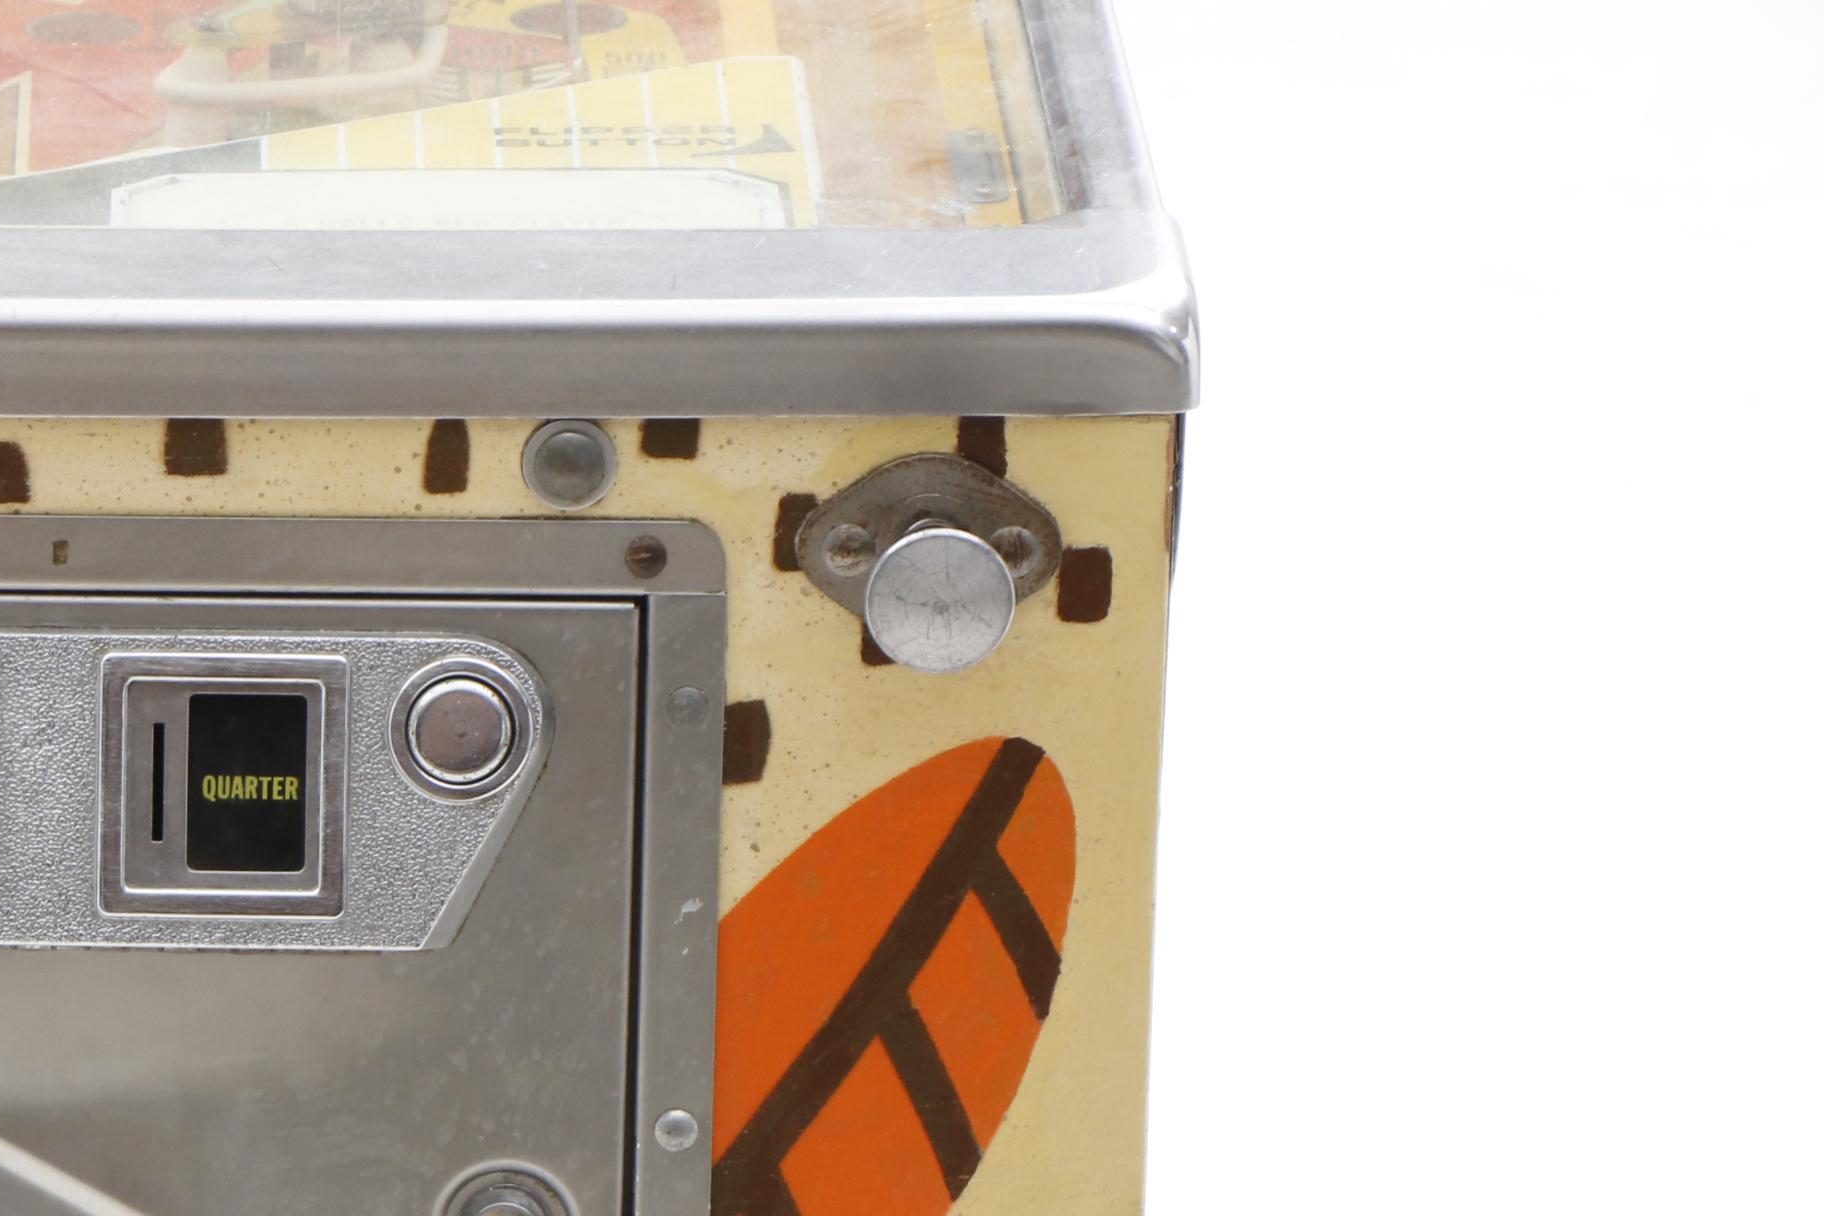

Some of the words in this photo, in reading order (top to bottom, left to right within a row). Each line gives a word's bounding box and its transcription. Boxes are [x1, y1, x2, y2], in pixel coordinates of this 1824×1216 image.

[493, 125, 736, 136] FLIPPER
[493, 137, 736, 148] BUTTON
[202, 774, 299, 801] QUARTER
